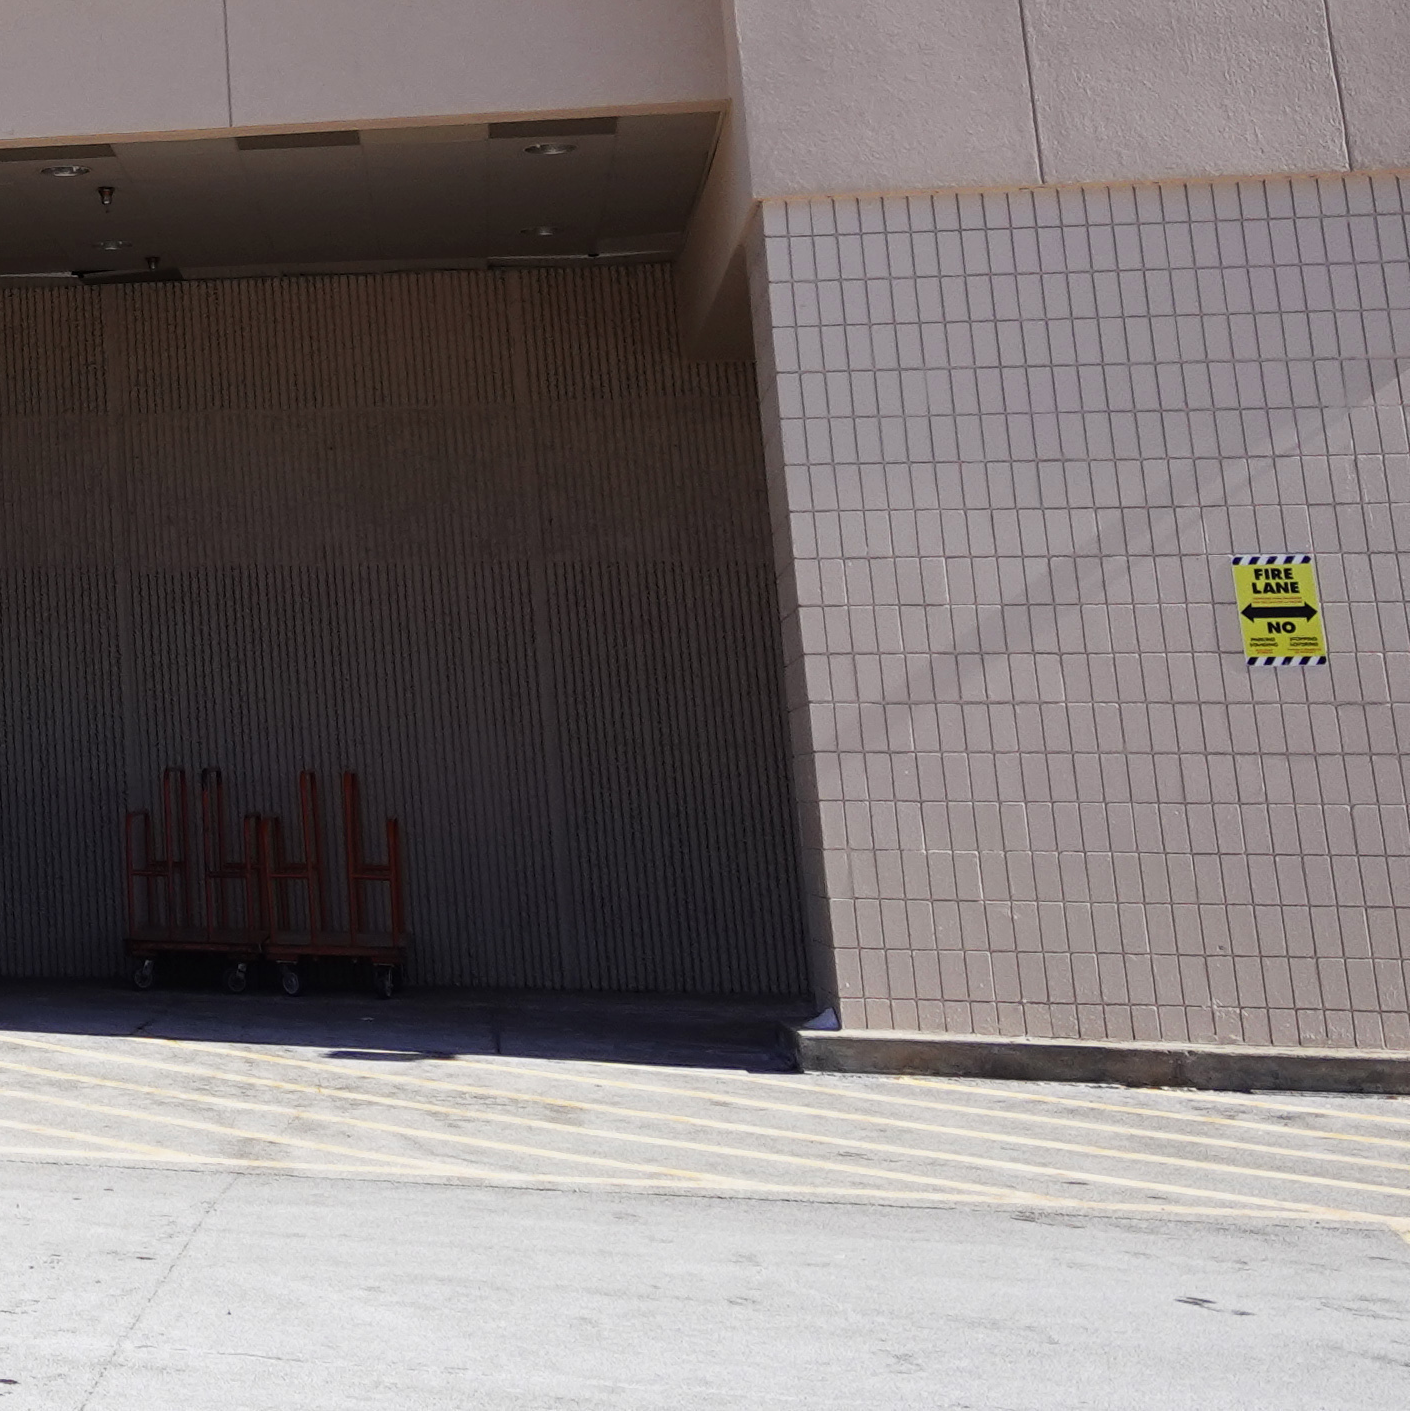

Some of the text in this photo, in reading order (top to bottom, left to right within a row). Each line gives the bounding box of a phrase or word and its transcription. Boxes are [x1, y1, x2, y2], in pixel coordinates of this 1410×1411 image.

[1254, 568, 1294, 580] FIRE
[1251, 582, 1300, 594] LANE
[1267, 622, 1296, 634] NO
